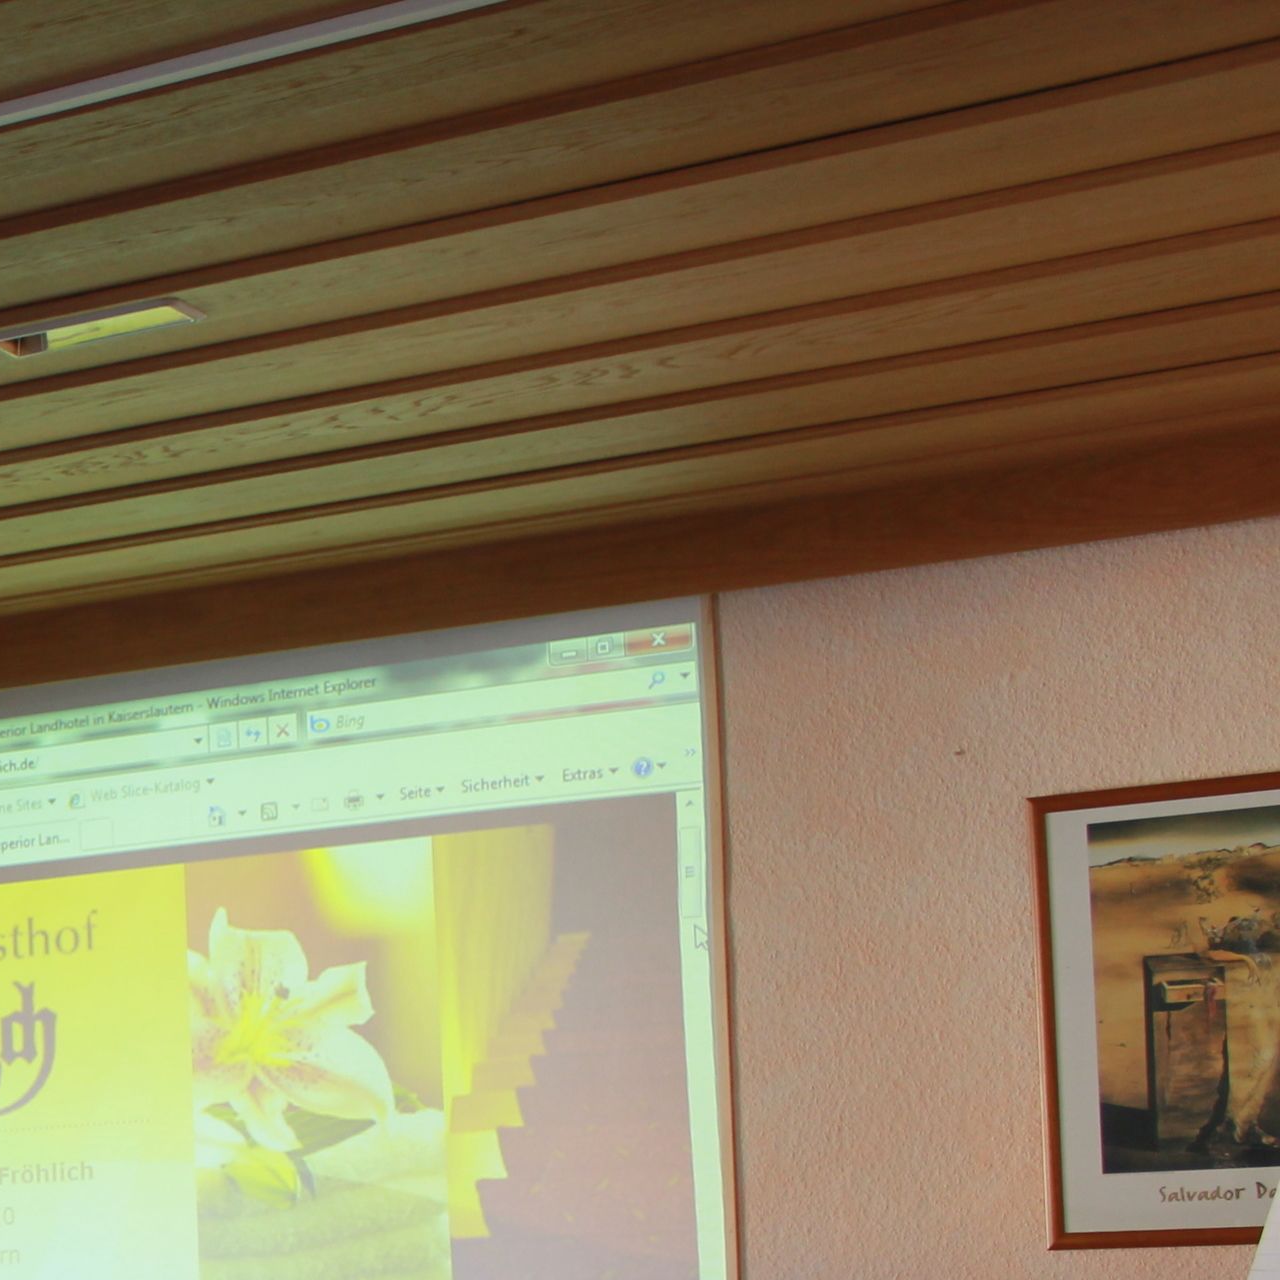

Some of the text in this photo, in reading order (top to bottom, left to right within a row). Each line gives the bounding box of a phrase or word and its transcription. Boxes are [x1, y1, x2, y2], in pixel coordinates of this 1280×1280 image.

[30, 715, 90, 736] Landhotel
[93, 713, 105, 726] in
[108, 700, 194, 724] Kaiserslautern
[206, 690, 265, 710] Windows
[268, 682, 320, 703] Internet
[324, 675, 377, 698] Explorer
[336, 714, 365, 731] Bing
[461, 773, 530, 794] Sicherheit
[562, 766, 603, 783] Extras
[90, 776, 200, 803] Web Slice-Katalog
[400, 784, 432, 800] Seite
[16, 798, 43, 813] Sites
[1159, 1181, 1278, 1203] Salvador Da
